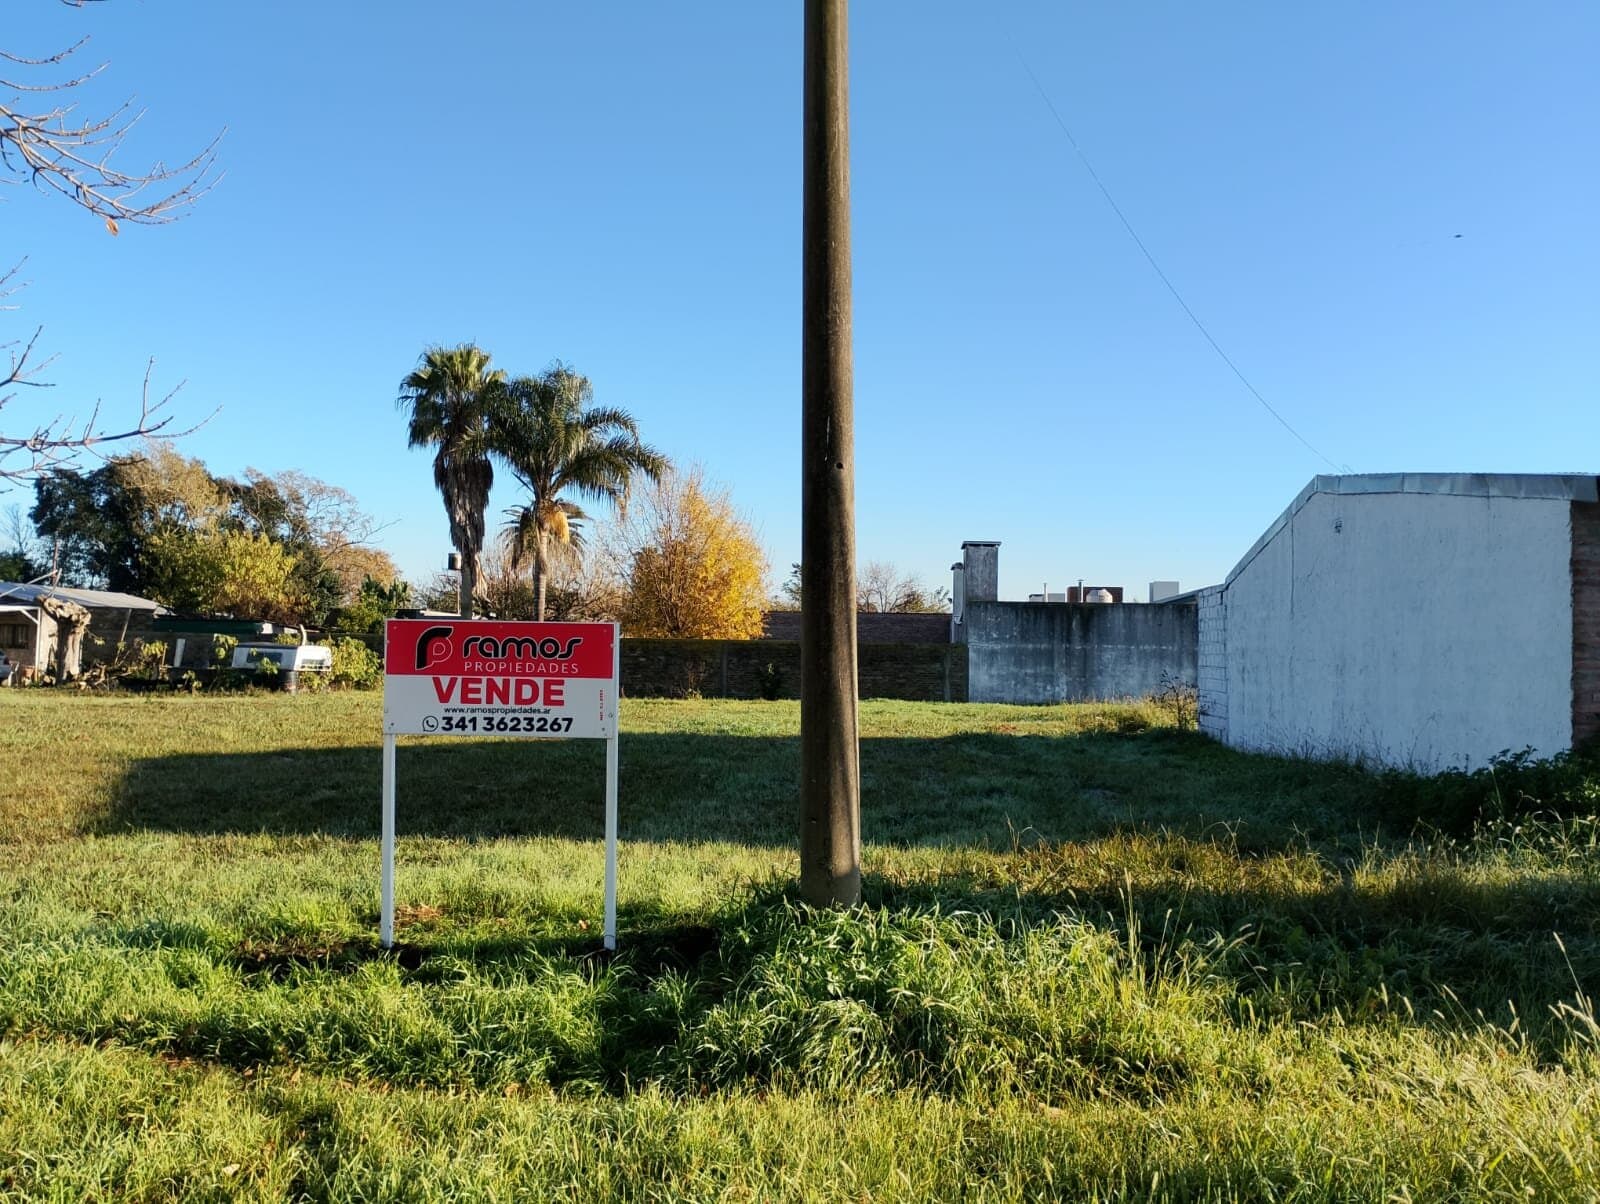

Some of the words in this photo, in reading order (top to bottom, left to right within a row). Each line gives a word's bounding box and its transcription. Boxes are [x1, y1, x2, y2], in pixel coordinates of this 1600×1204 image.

[462, 636, 583, 660] ramos
[464, 662, 579, 673] PROPIEDADES
[432, 677, 565, 706] VENDE
[444, 706, 551, 715] www.ramospropiedades.ar
[442, 716, 477, 731] 341
[482, 717, 573, 733] 3623267
